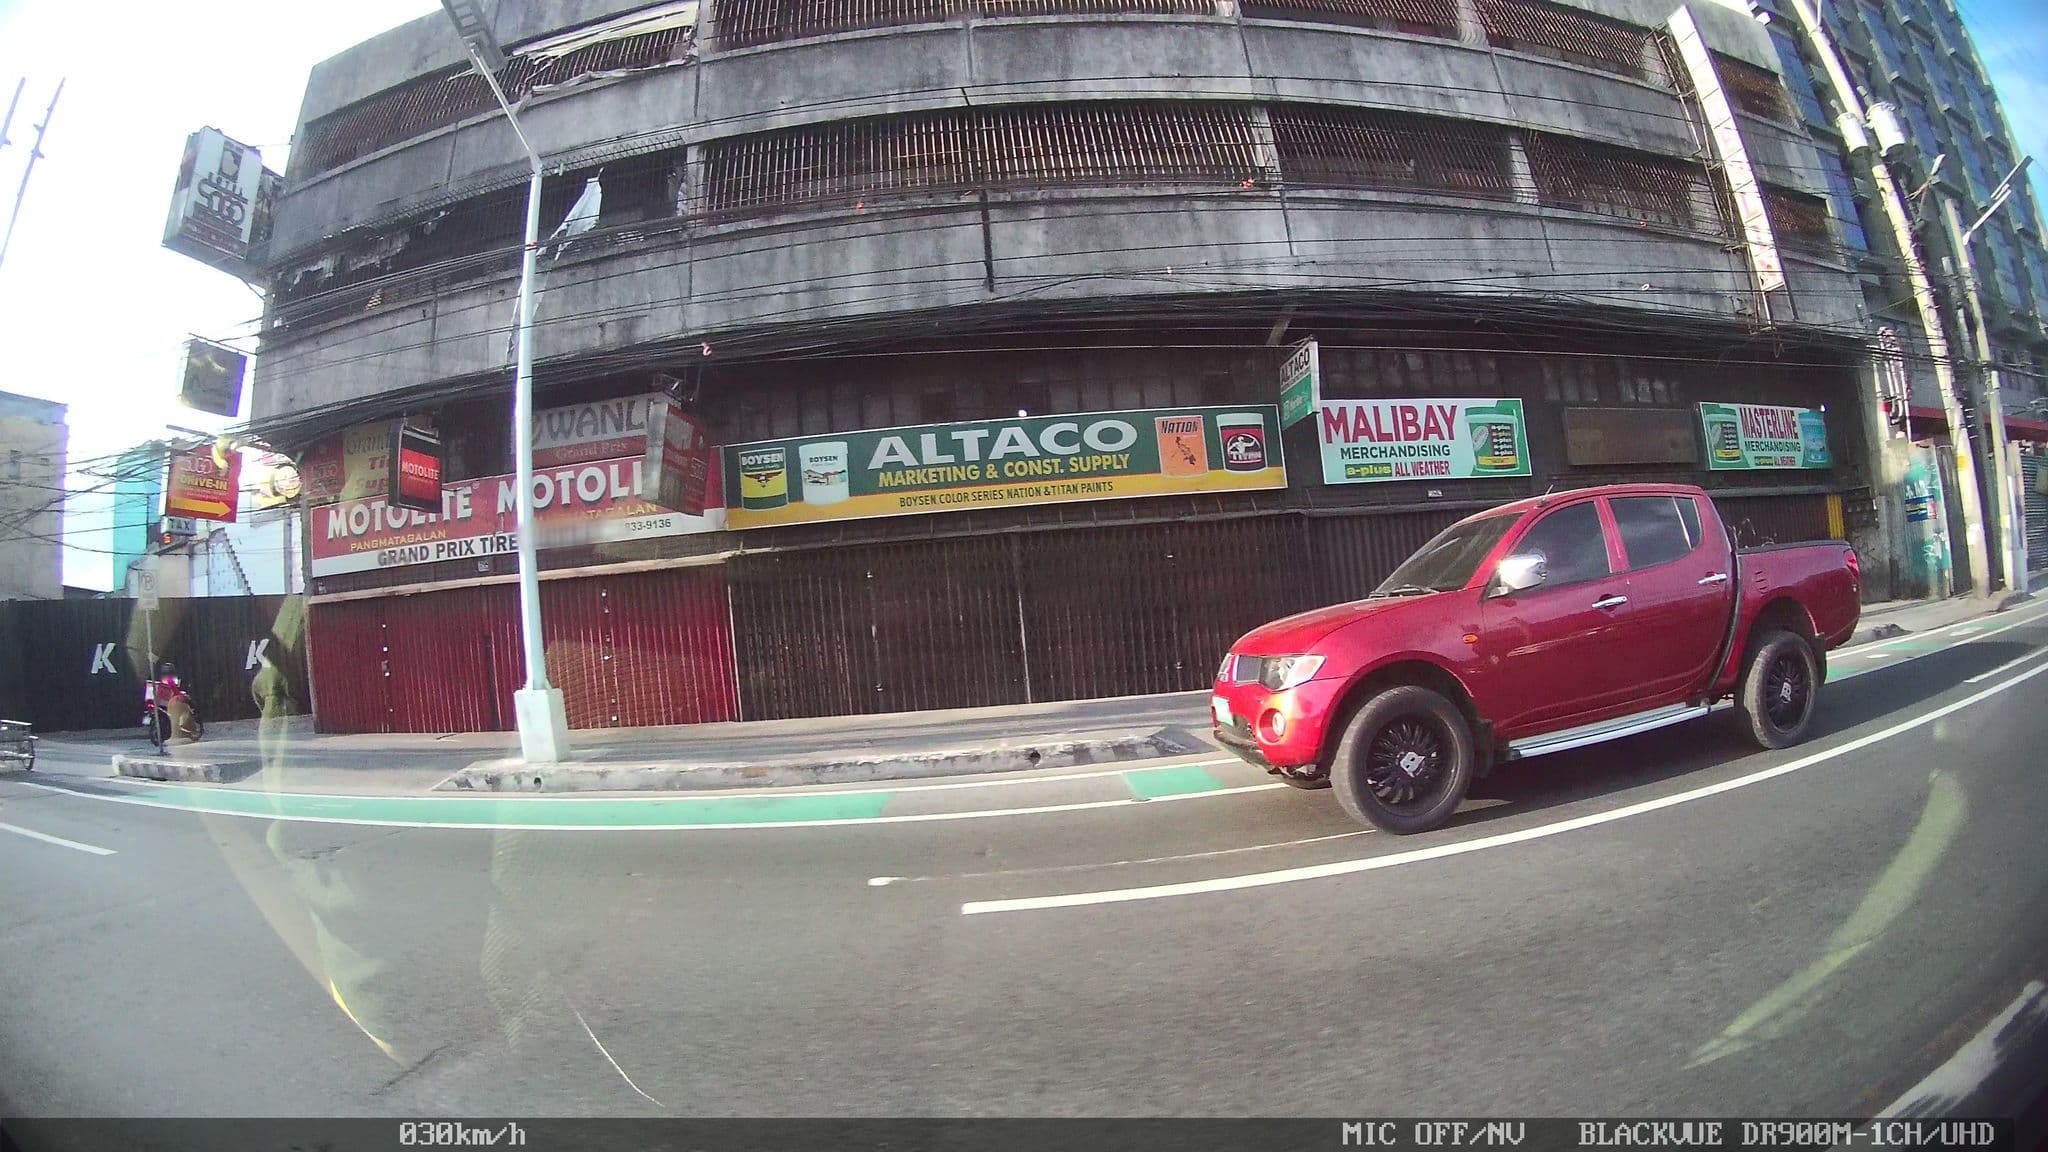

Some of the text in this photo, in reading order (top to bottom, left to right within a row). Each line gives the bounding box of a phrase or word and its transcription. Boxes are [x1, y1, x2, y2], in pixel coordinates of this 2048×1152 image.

[1280, 347, 1310, 385] ALTACO
[1161, 420, 1198, 434] NATION
[1322, 405, 1457, 444] MALIBAY
[1740, 407, 1799, 440] MASTERLINE
[868, 420, 1138, 470] ALTACO
[1340, 445, 1451, 460] MERCHANDISING
[1744, 441, 1801, 452] MERCHANDISING
[402, 461, 440, 480] MOTOLITE
[741, 453, 784, 466] BOYSEN
[878, 454, 1130, 488] MARKETING & CONST. SUPPLY
[1346, 461, 1450, 477] a-plus ALL WEATHER
[900, 496, 936, 507] BOYSEN
[939, 492, 969, 504] COLOR
[972, 489, 1004, 501] SERIES
[1007, 486, 1041, 499] NATION
[1081, 481, 1114, 493] PAINTS
[350, 529, 447, 552] PANGMATAGALAN
[377, 546, 430, 567] GRAND
[435, 539, 476, 559] PRIX
[90, 642, 118, 675] K
[244, 637, 271, 671] K
